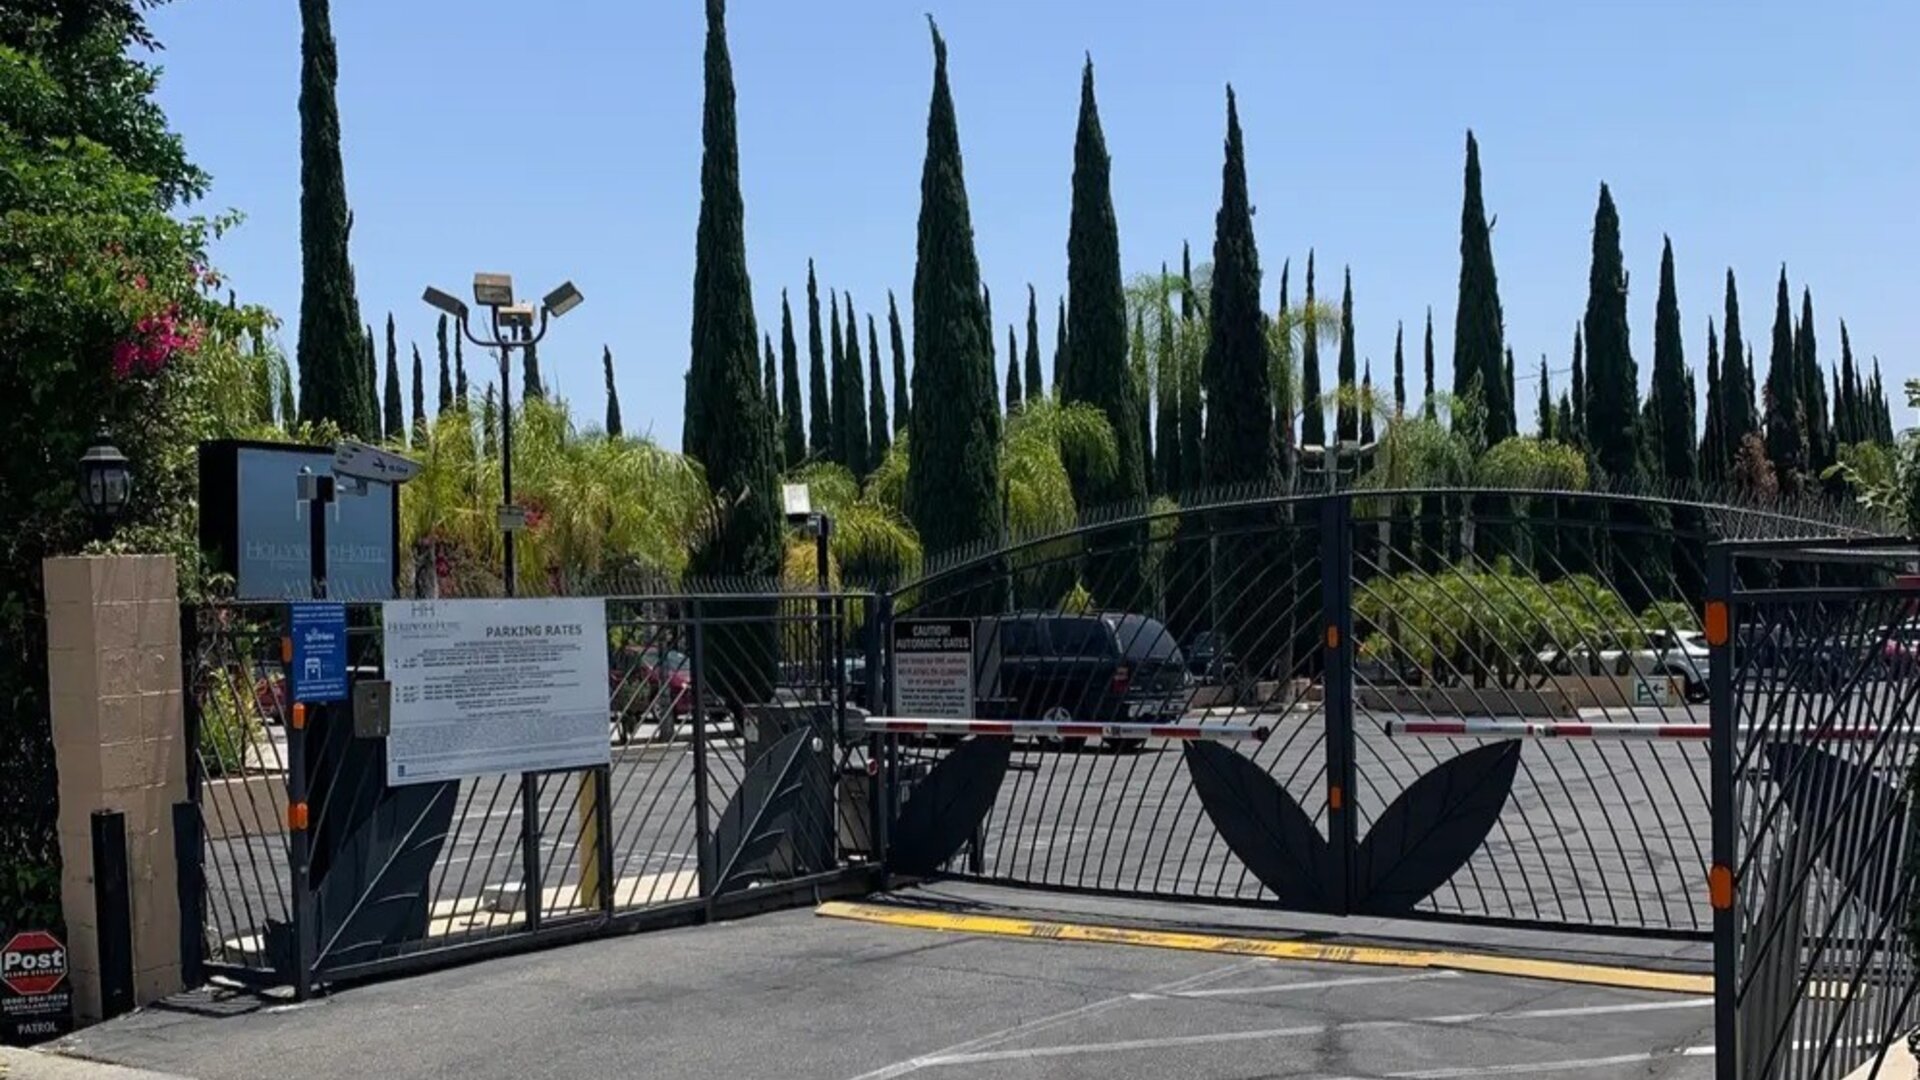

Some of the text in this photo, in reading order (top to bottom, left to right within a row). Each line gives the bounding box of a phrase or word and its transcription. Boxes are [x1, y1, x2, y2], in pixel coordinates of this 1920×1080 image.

[486, 623, 583, 638] PARKING RATES
[912, 625, 951, 636] CAUTION!
[896, 637, 969, 649] AUTOMATIC GATES
[4, 951, 63, 971] Post
[17, 1021, 57, 1034] PATROL
